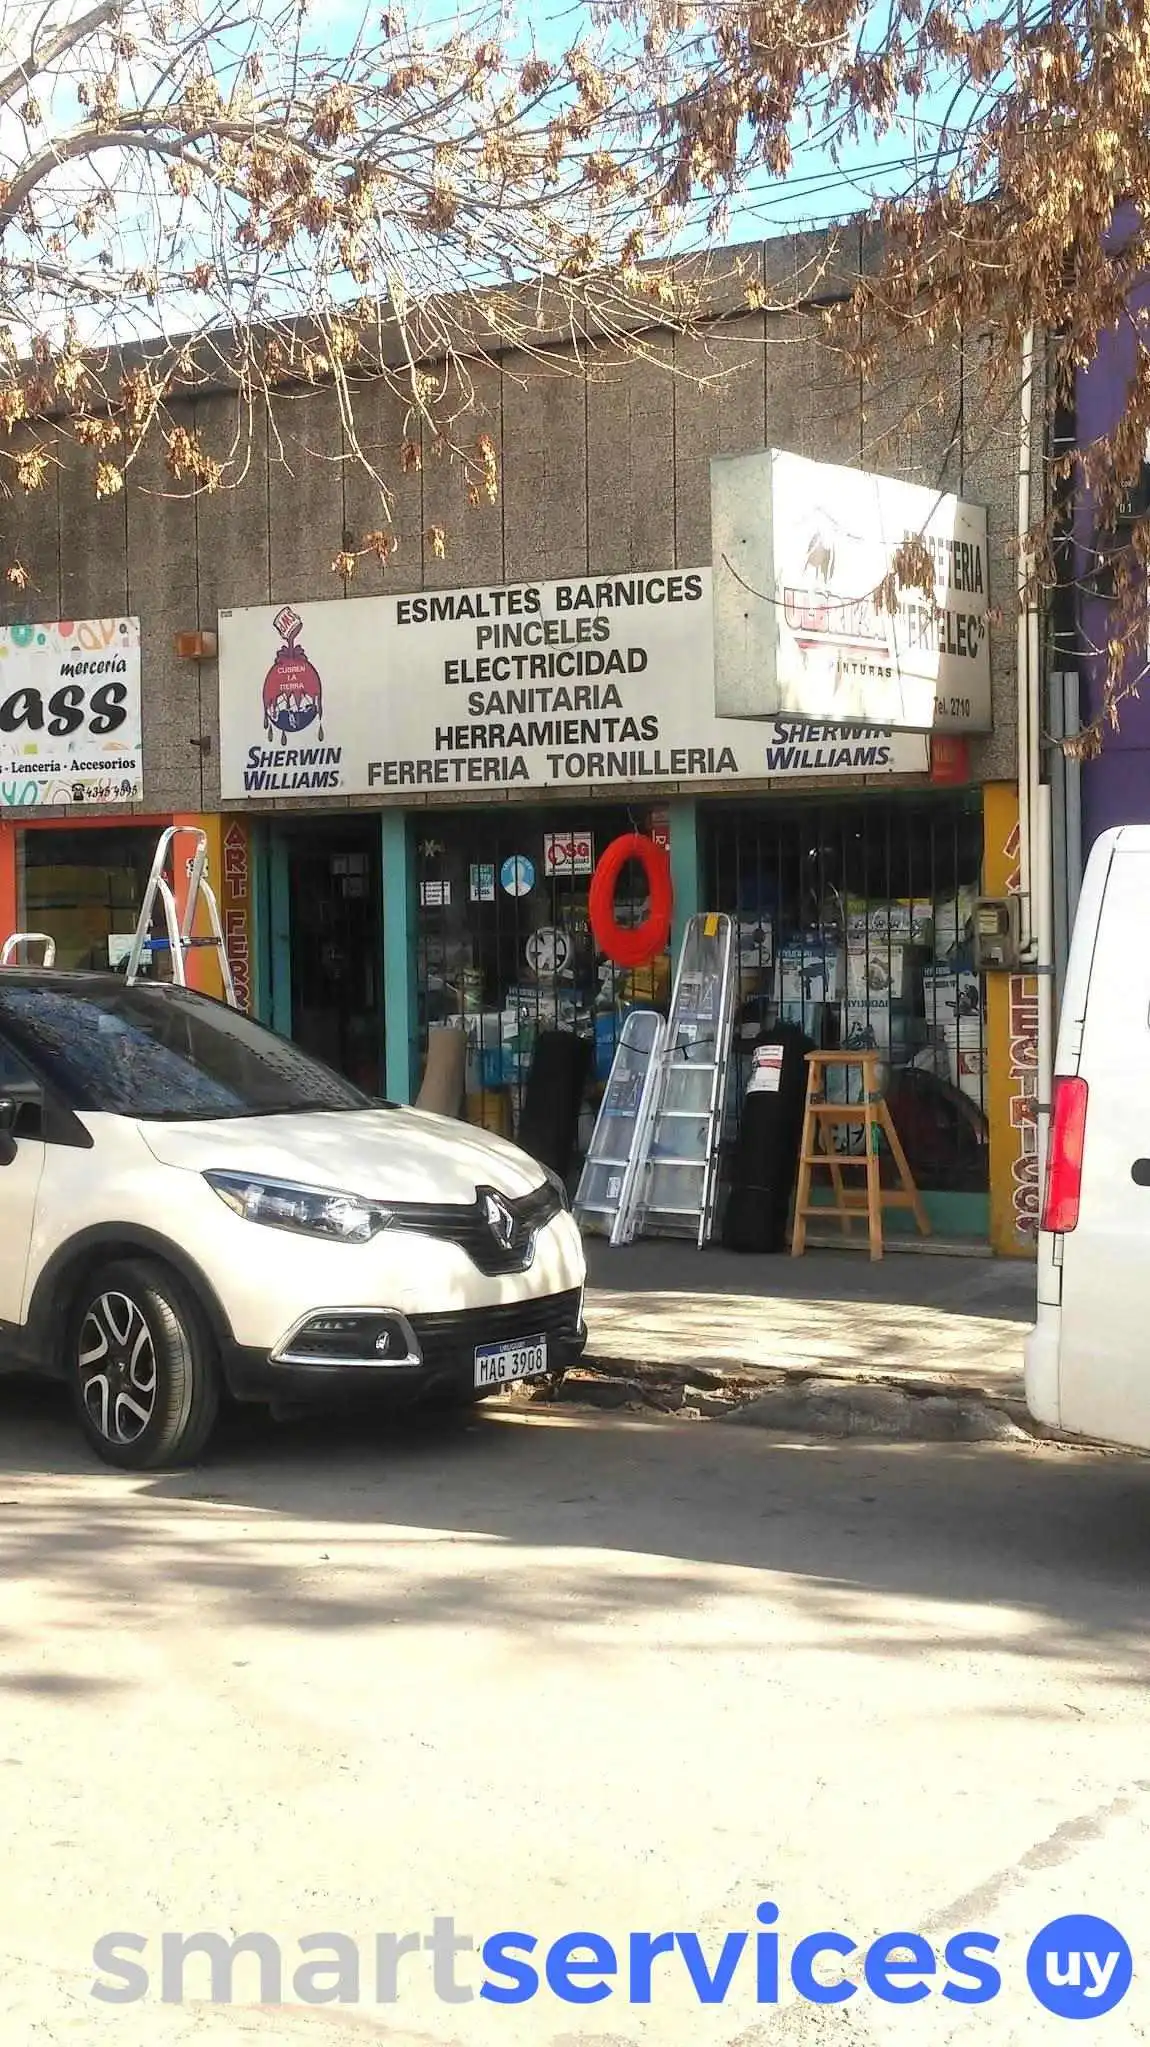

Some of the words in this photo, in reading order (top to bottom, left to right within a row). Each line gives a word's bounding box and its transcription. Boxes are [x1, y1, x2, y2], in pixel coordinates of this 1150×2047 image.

[397, 588, 541, 624] ESMALTES
[556, 575, 703, 611] BARNICES
[476, 616, 610, 650] PINCELES
[60, 653, 127, 677] mercería
[444, 647, 648, 684] ELECTRICIDAD
[831, 661, 893, 678] INTURAS
[468, 684, 623, 716] SANITARIA
[951, 698, 970, 717] 2710
[435, 715, 659, 751] HERRAMIENTAS
[70, 758, 136, 772] Accesorios
[246, 746, 342, 769] SHERWIN
[367, 756, 530, 787] FERRETERIA
[547, 746, 739, 779] TORNILLERIA
[766, 746, 890, 770] WILLIAMS
[243, 770, 340, 791] WILLIAMS
[844, 1000, 889, 1008] HYUDAI
[1009, 974, 1039, 1234] LECTRICOS
[480, 1356, 505, 1381] MAG
[511, 1348, 543, 1375] 3908
